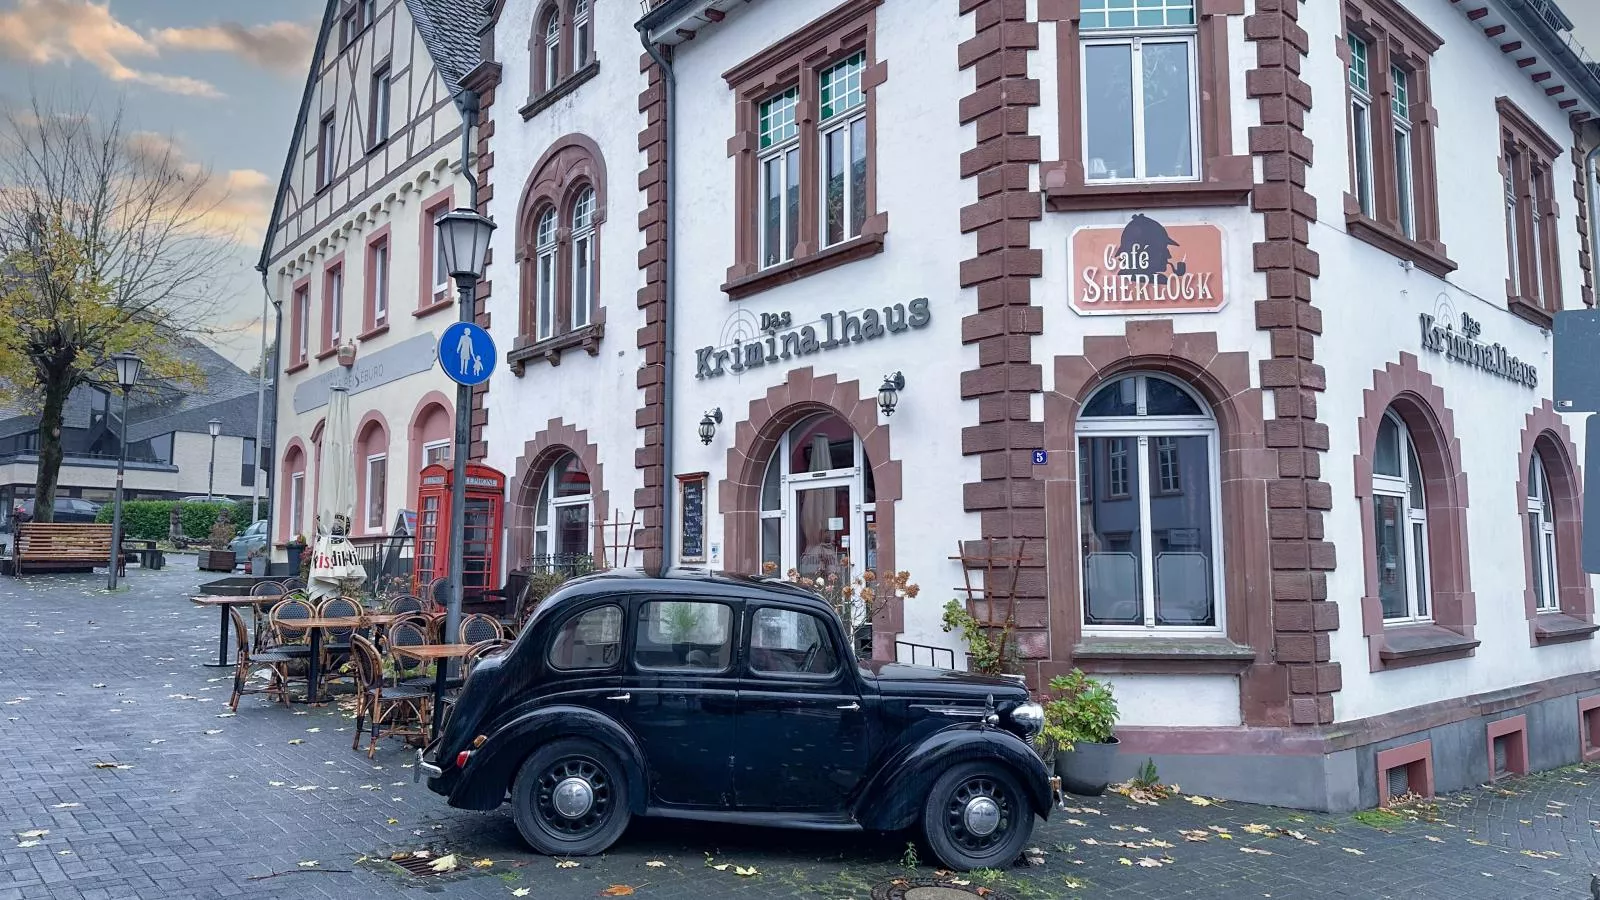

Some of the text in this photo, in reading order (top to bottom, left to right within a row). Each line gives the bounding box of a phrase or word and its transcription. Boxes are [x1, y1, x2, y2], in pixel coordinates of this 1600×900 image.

[1104, 243, 1150, 271] Café
[760, 311, 791, 331] Das
[1461, 311, 1481, 335] Das
[695, 297, 931, 380] Kriminalhaus
[1420, 312, 1538, 388] Kriminalhaus
[1036, 452, 1044, 463] 5
